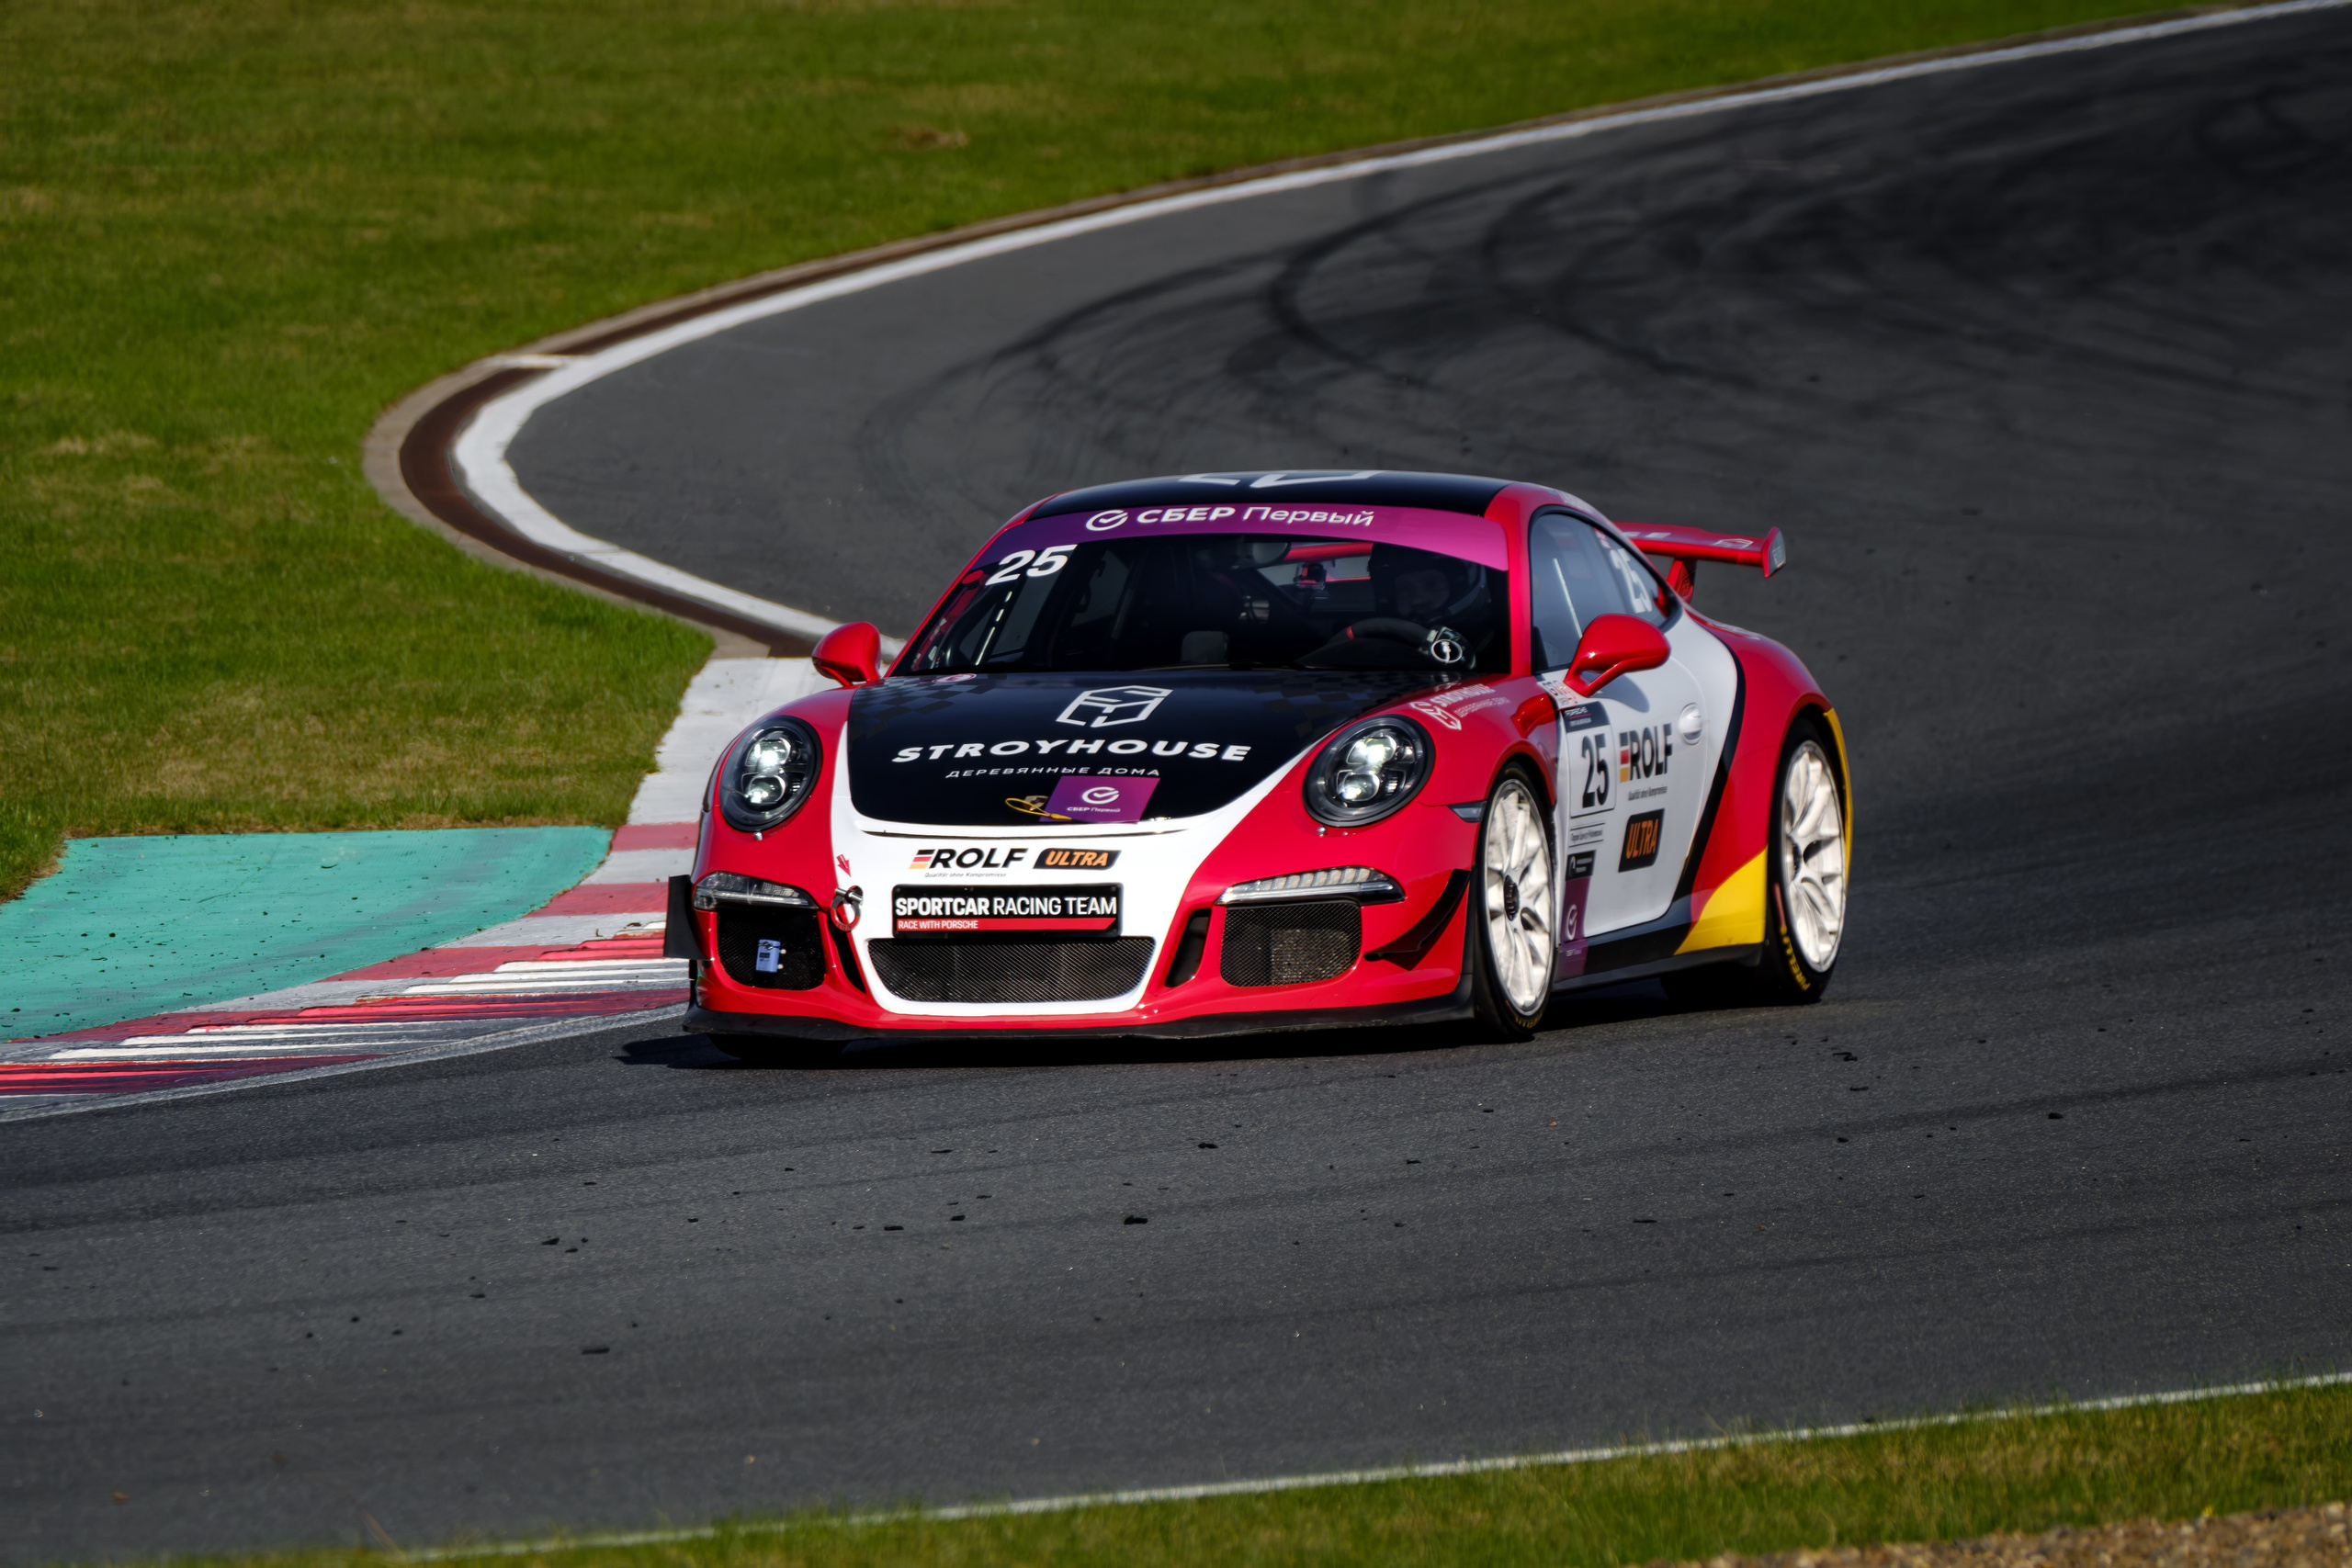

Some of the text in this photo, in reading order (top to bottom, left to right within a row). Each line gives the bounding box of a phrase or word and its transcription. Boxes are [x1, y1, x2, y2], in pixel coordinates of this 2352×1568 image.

[1136, 505, 1374, 527] СБЕР Первый
[985, 544, 1078, 586] 25
[1610, 547, 1653, 614] 25
[891, 739, 1252, 762] STROYHOUSE
[1629, 723, 1673, 781] ROLF
[945, 766, 1159, 779] ДЕРЕВЯННЫЕ ДОМА
[1581, 732, 1610, 808] 25
[1625, 818, 1659, 860] ULTRA
[928, 848, 1109, 869] ROLF ULTRA
[895, 897, 1117, 917] SPORTCAR RACING TEAM
[898, 920, 978, 930] RACE WITH PORSCHE
